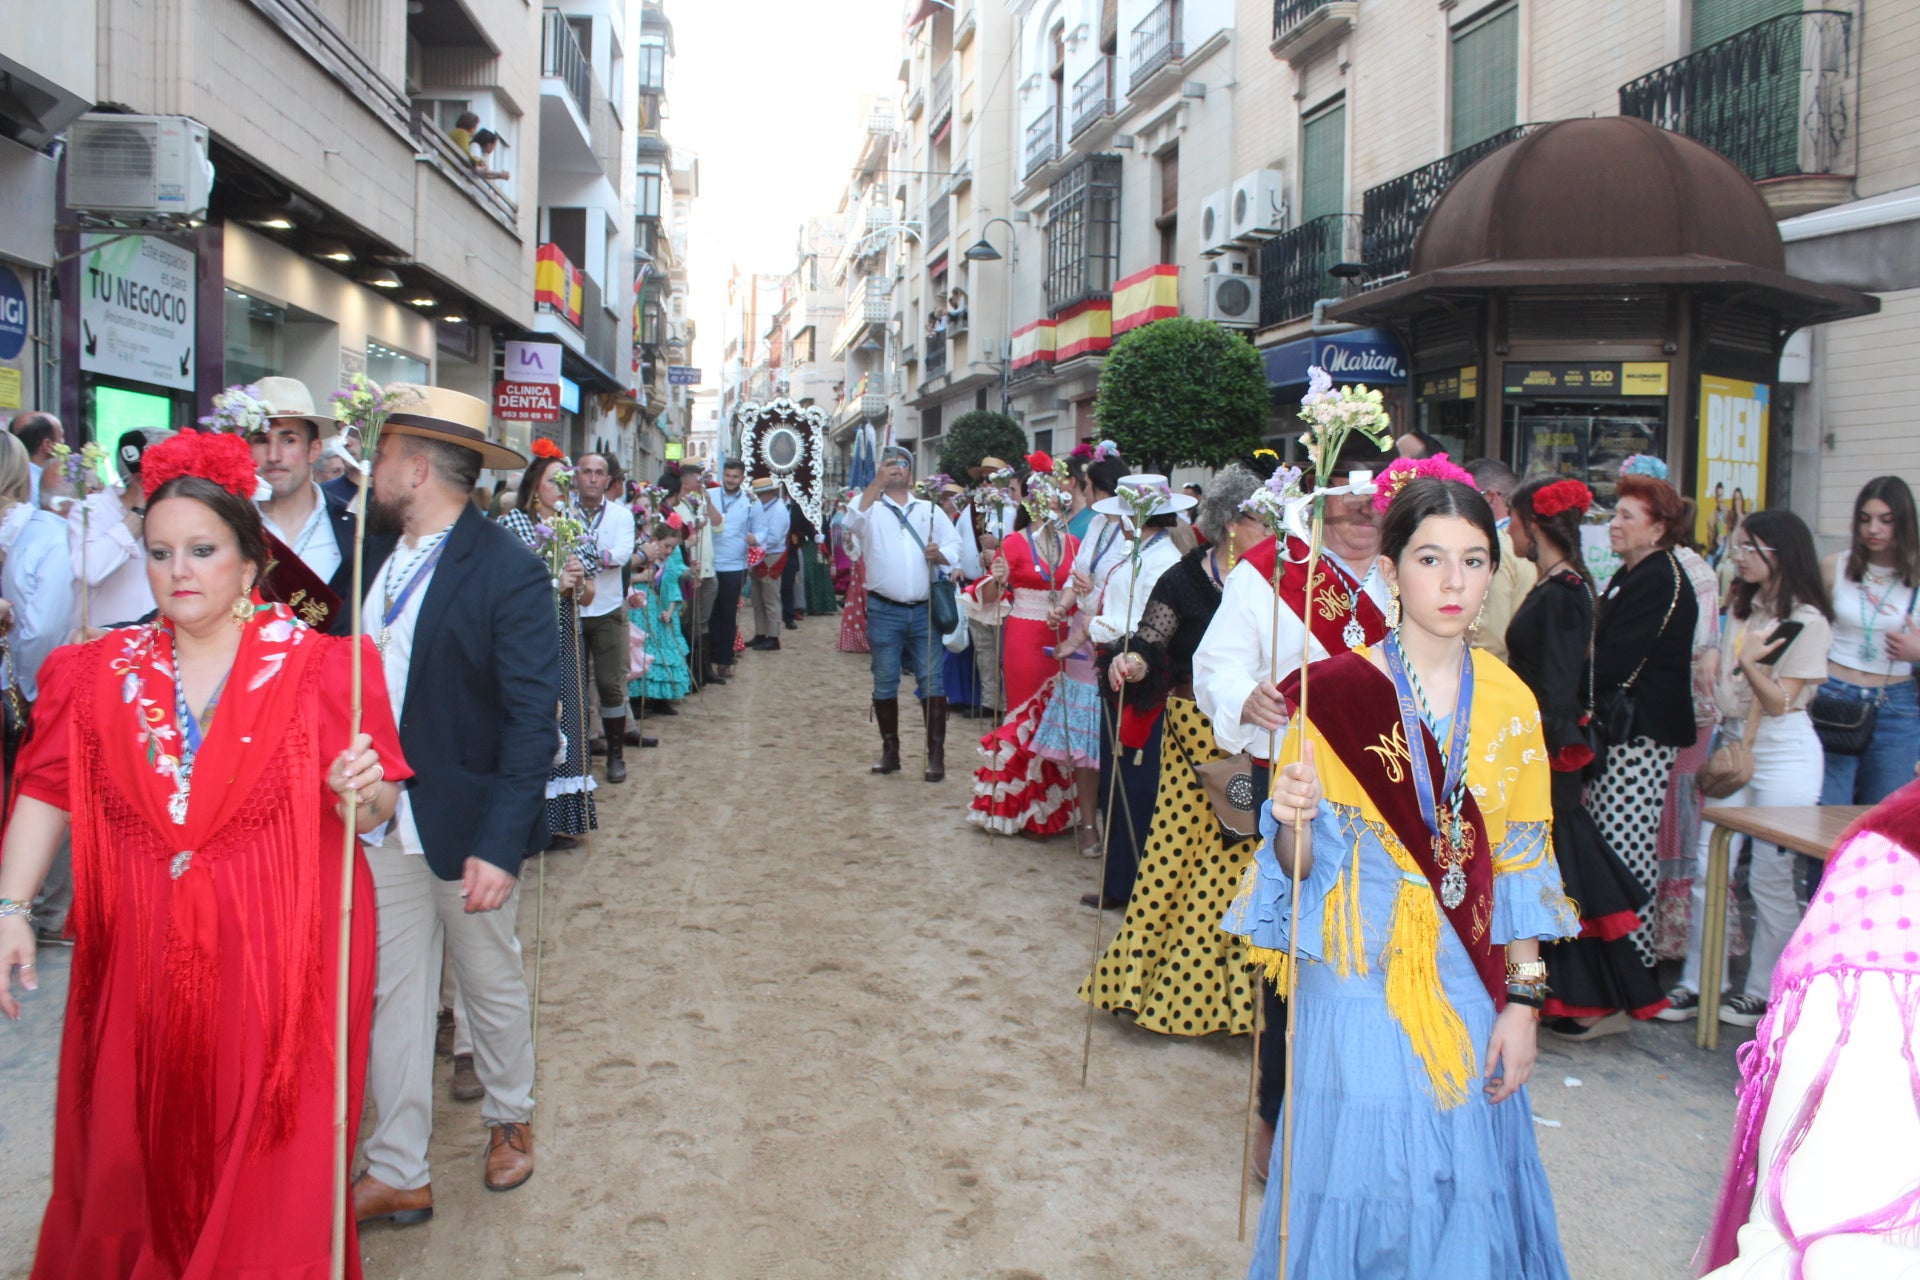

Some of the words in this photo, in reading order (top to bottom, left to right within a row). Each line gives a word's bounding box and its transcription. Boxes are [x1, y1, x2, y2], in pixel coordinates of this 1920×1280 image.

[88, 267, 112, 304] TU
[117, 276, 187, 325] NEGOCIO
[0, 295, 24, 326] IGI
[1590, 370, 1614, 382] 120
[506, 385, 552, 396] CLINICA
[498, 395, 557, 410] DENTAL
[1706, 393, 1761, 463] BIEN
